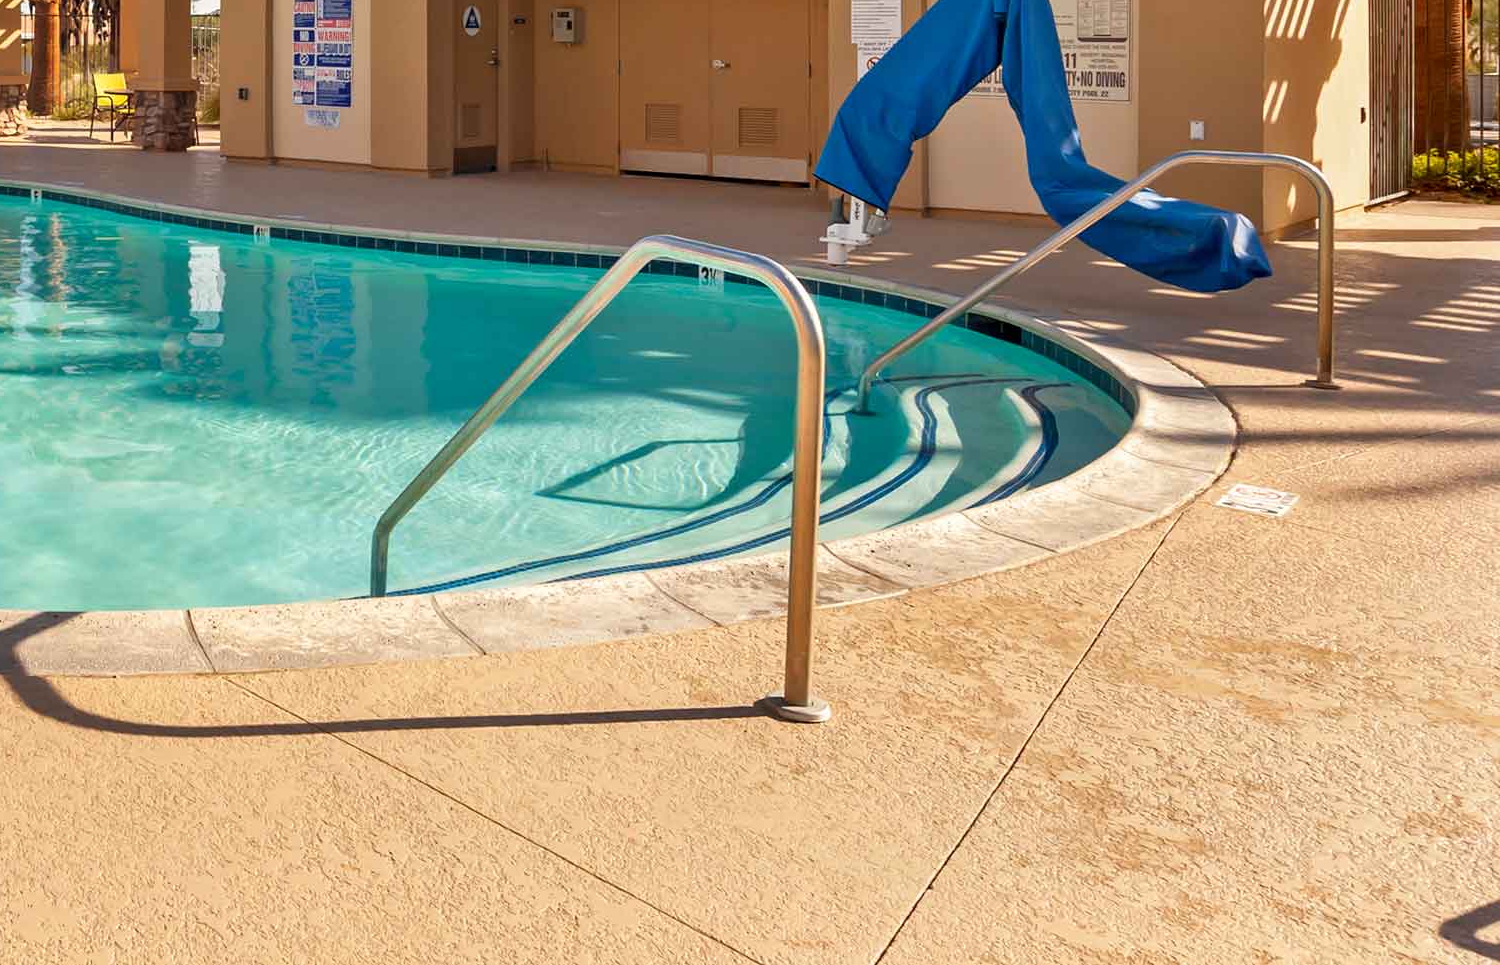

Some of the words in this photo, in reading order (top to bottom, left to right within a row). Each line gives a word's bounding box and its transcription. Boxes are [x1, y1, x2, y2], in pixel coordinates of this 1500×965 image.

[1064, 52, 1076, 68] 11
[1067, 71, 1077, 86] TY
[1080, 71, 1093, 87] NO
[1096, 72, 1126, 88] DIVING
